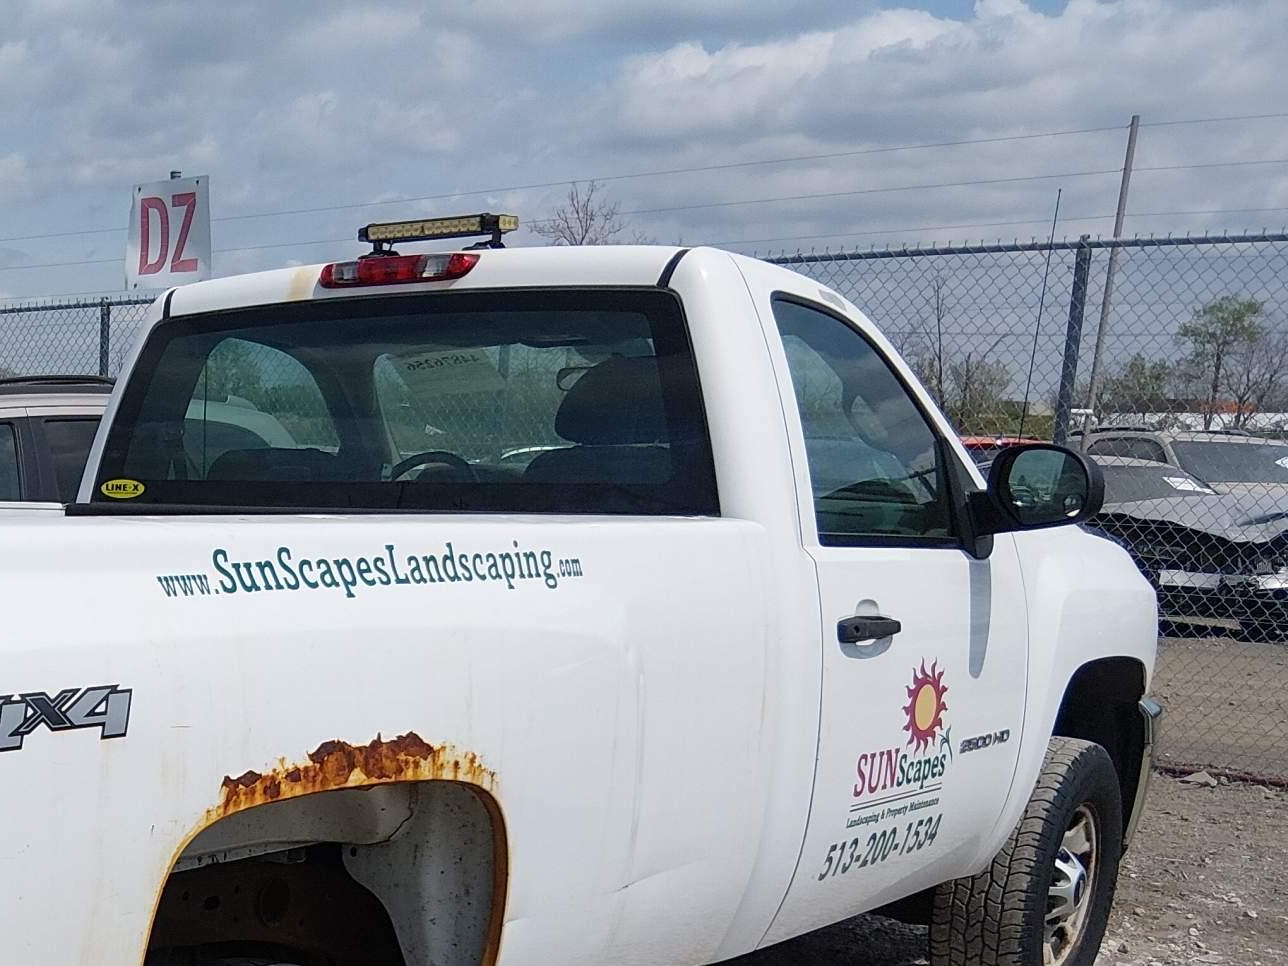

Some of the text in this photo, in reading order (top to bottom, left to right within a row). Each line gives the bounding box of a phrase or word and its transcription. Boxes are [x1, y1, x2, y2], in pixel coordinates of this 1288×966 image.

[138, 192, 198, 275] DZ
[846, 812, 880, 828] Landscaping
[885, 804, 908, 819] Property
[908, 797, 940, 812] Maintenance
[818, 813, 943, 881] 513-200-1534
